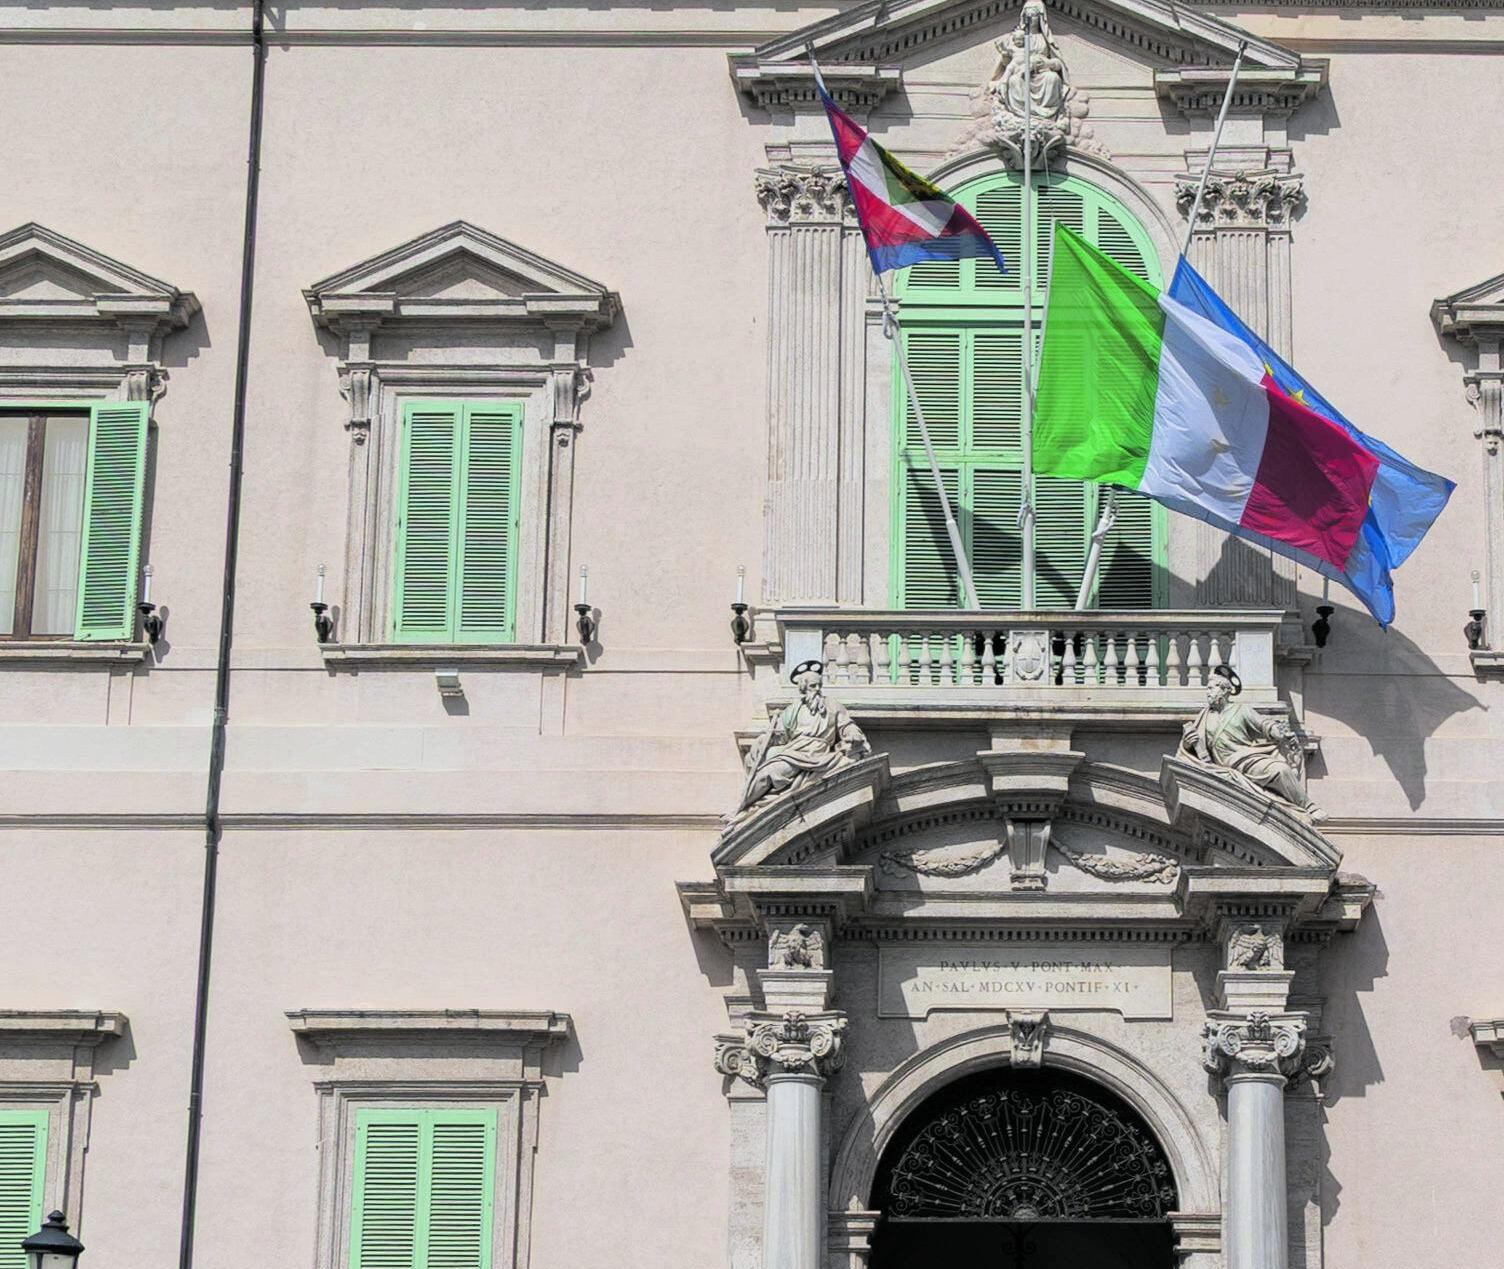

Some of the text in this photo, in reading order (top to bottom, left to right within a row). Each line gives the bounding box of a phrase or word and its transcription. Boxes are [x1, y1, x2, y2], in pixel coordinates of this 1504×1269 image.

[940, 961, 1000, 972] PAVLVS
[1032, 961, 1072, 973] PONT
[1081, 961, 1112, 973] MAX
[911, 981, 1130, 993] AN SAL MDCXV PONTIF XI
